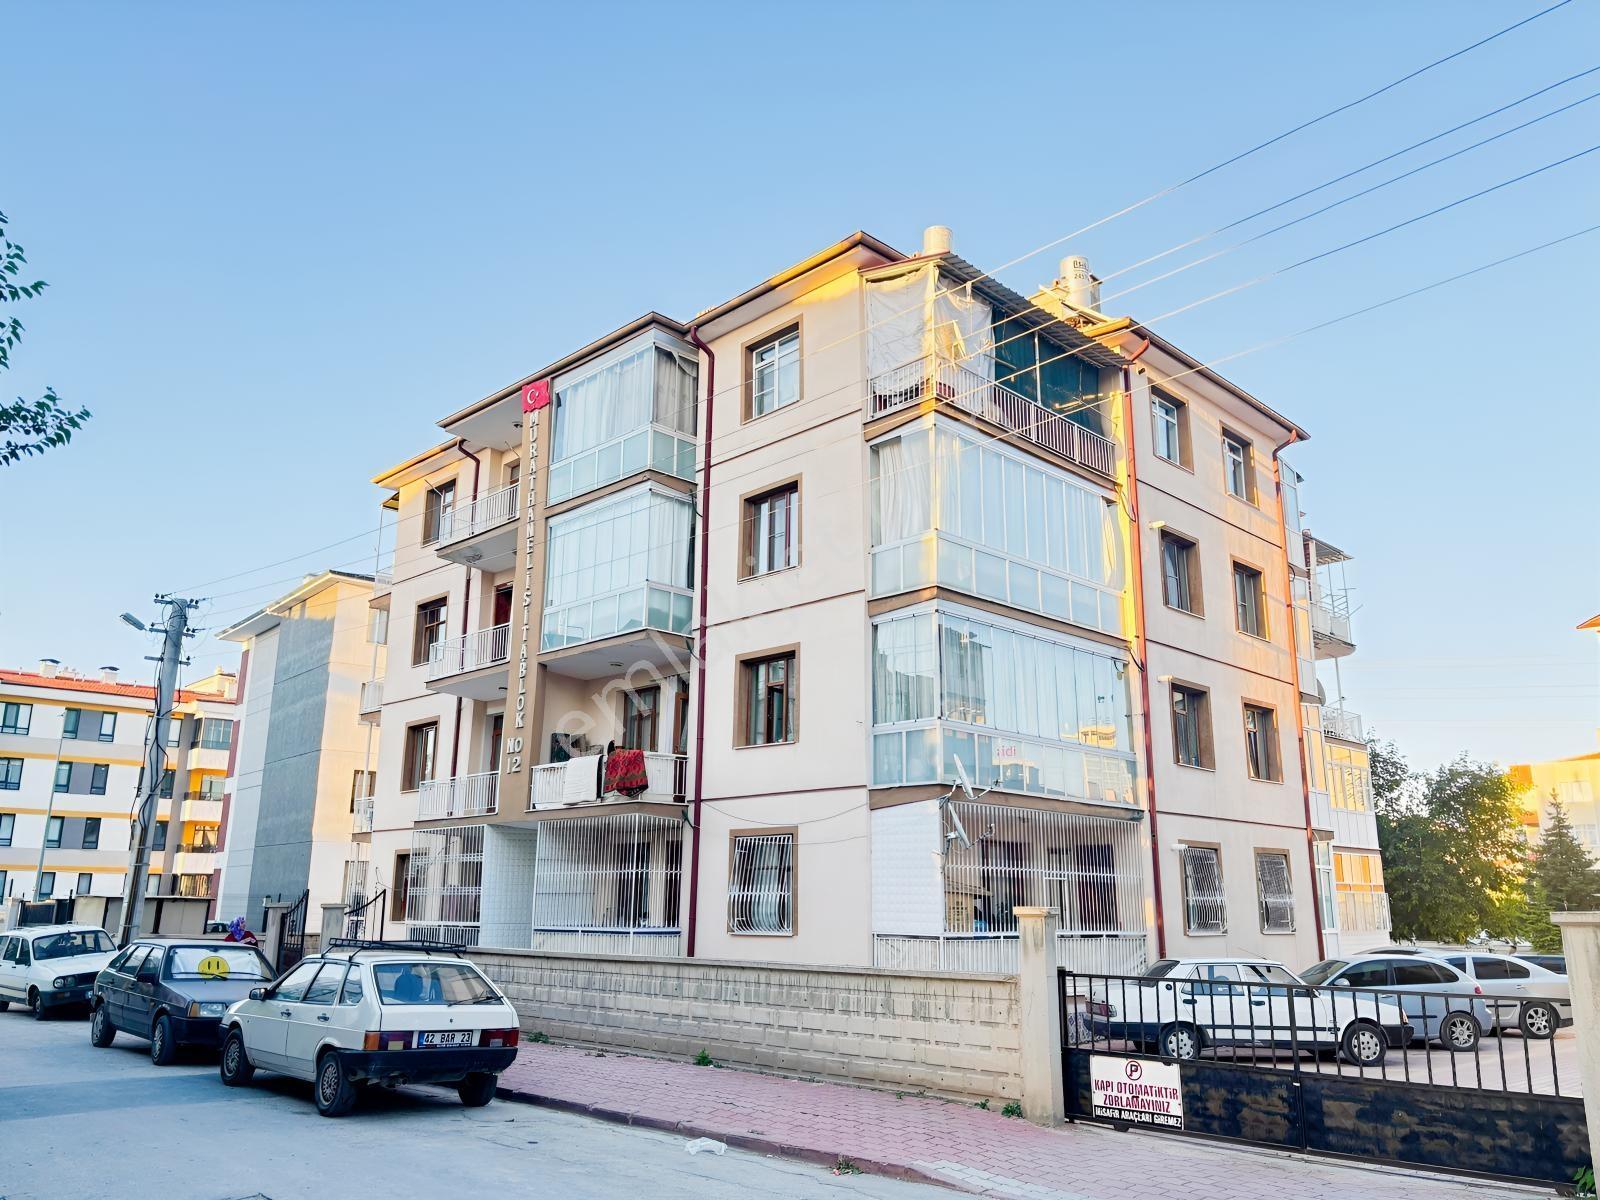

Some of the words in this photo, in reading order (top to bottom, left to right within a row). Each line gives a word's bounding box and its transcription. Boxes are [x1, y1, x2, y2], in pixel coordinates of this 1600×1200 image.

[506, 737, 524, 754] NO
[506, 755, 522, 774] 12
[425, 1034, 435, 1043] 42
[440, 1034, 455, 1043] BAR
[461, 1033, 470, 1043] 23
[1094, 1079, 1114, 1092] KAPI
[1103, 1094, 1171, 1113] ZORLAMAYINIZ
